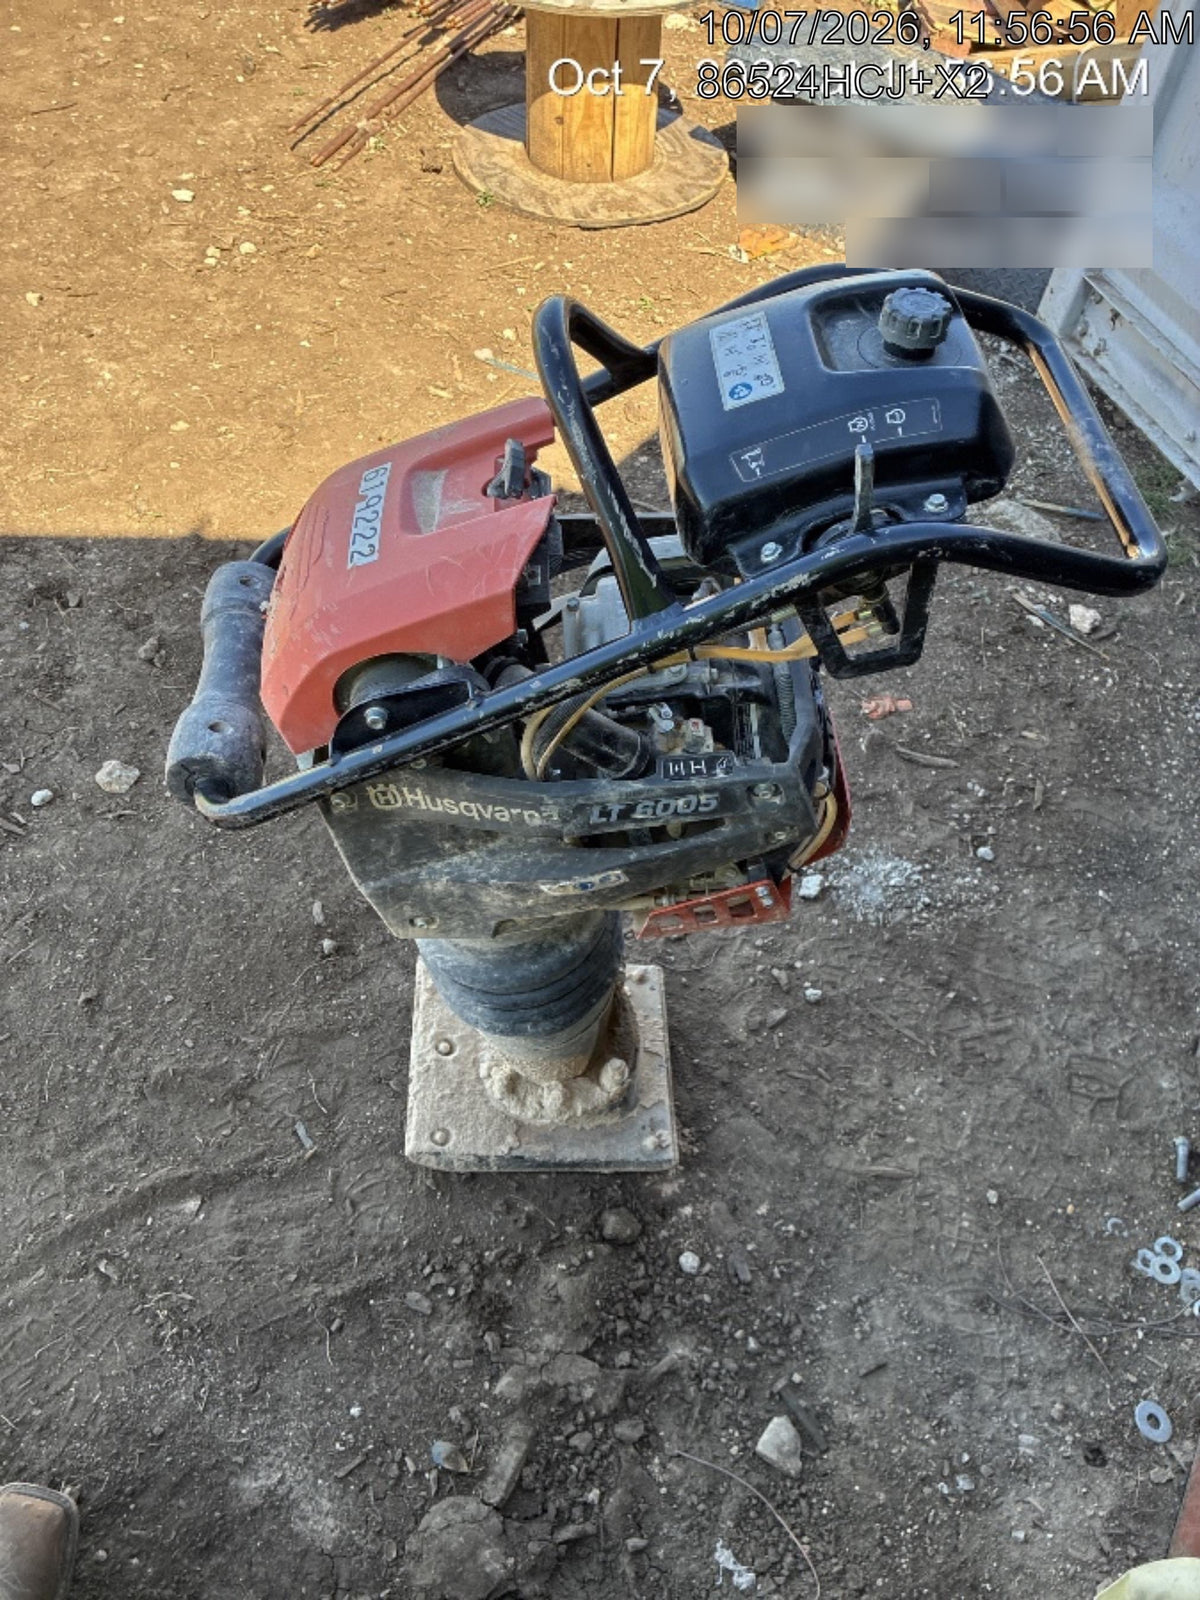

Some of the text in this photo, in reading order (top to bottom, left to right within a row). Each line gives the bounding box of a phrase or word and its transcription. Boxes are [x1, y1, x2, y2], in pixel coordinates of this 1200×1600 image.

[349, 465, 389, 564] 619222
[402, 786, 560, 827] Husqvarna
[589, 802, 626, 825] LT
